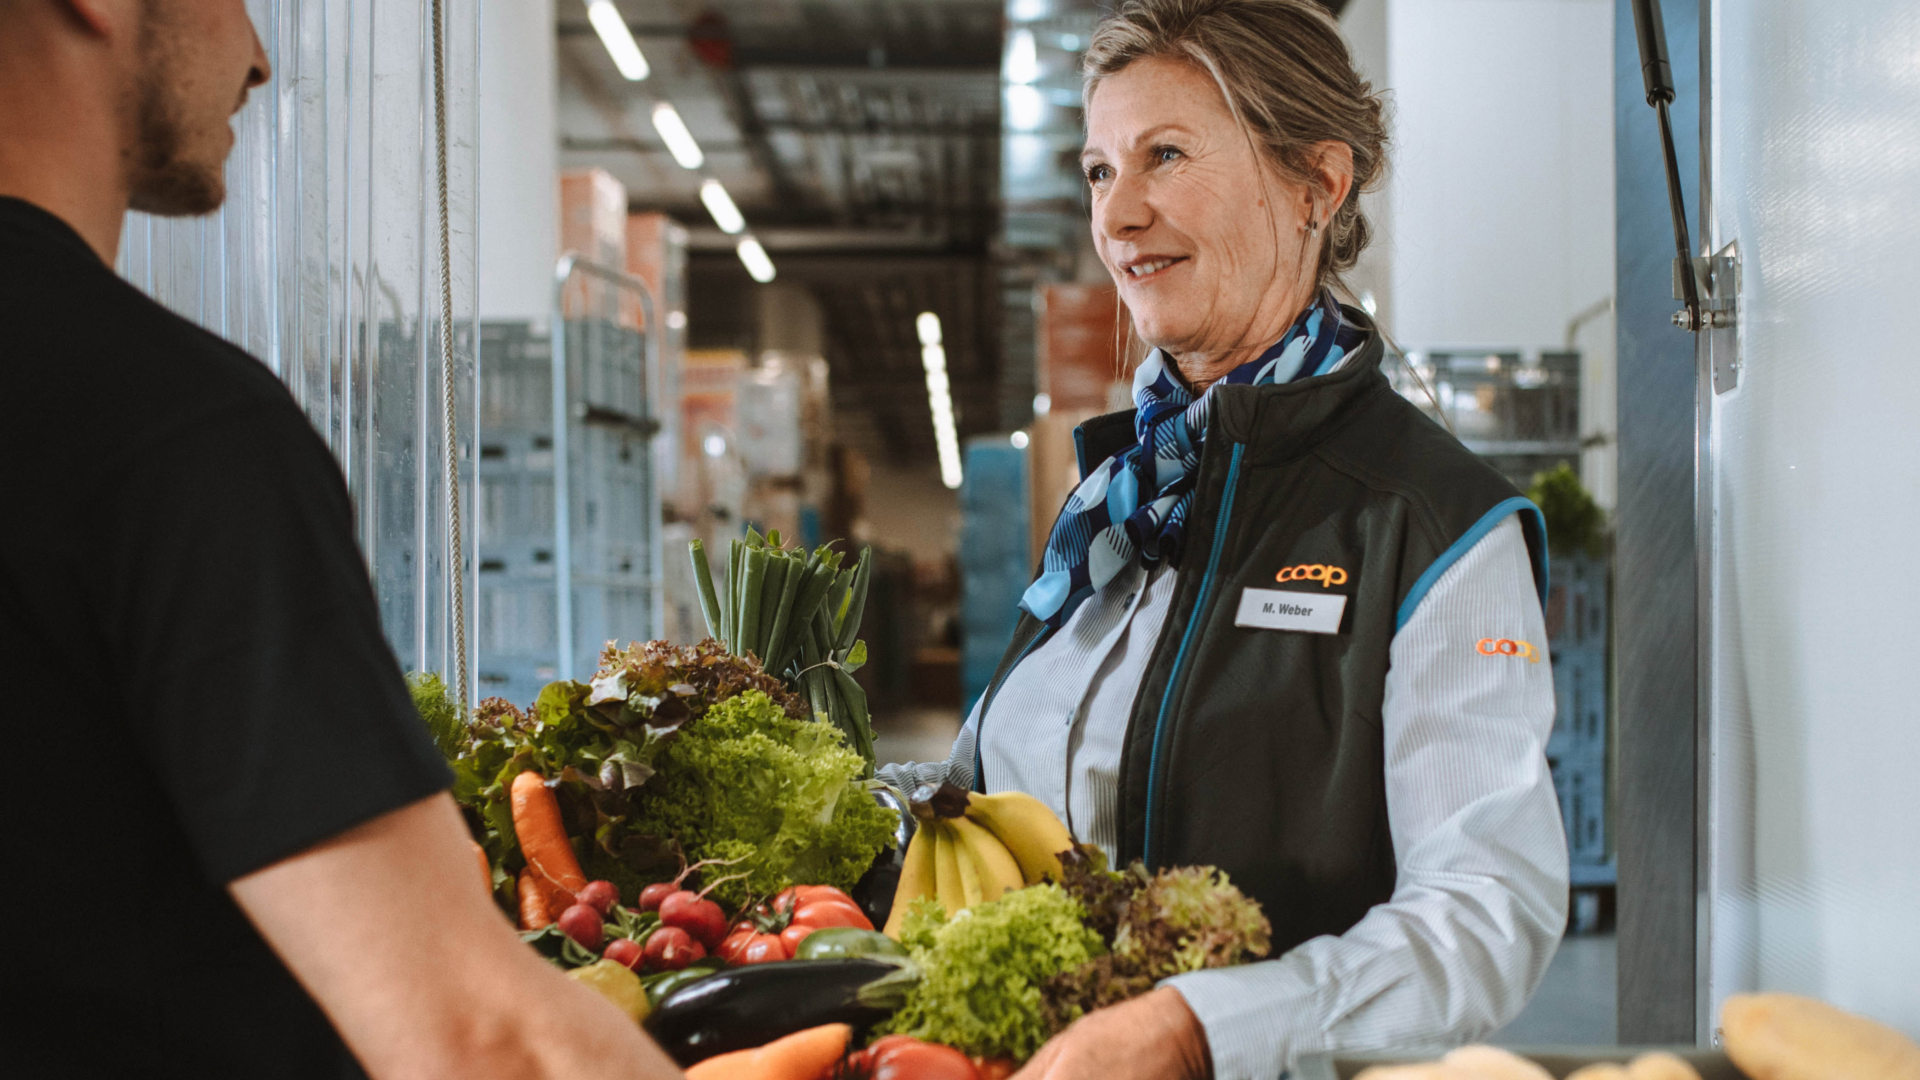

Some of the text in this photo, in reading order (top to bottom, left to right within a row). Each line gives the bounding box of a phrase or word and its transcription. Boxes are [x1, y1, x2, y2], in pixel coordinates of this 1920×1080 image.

[1275, 564, 1348, 588] coop
[1262, 602, 1313, 617] M. Weber
